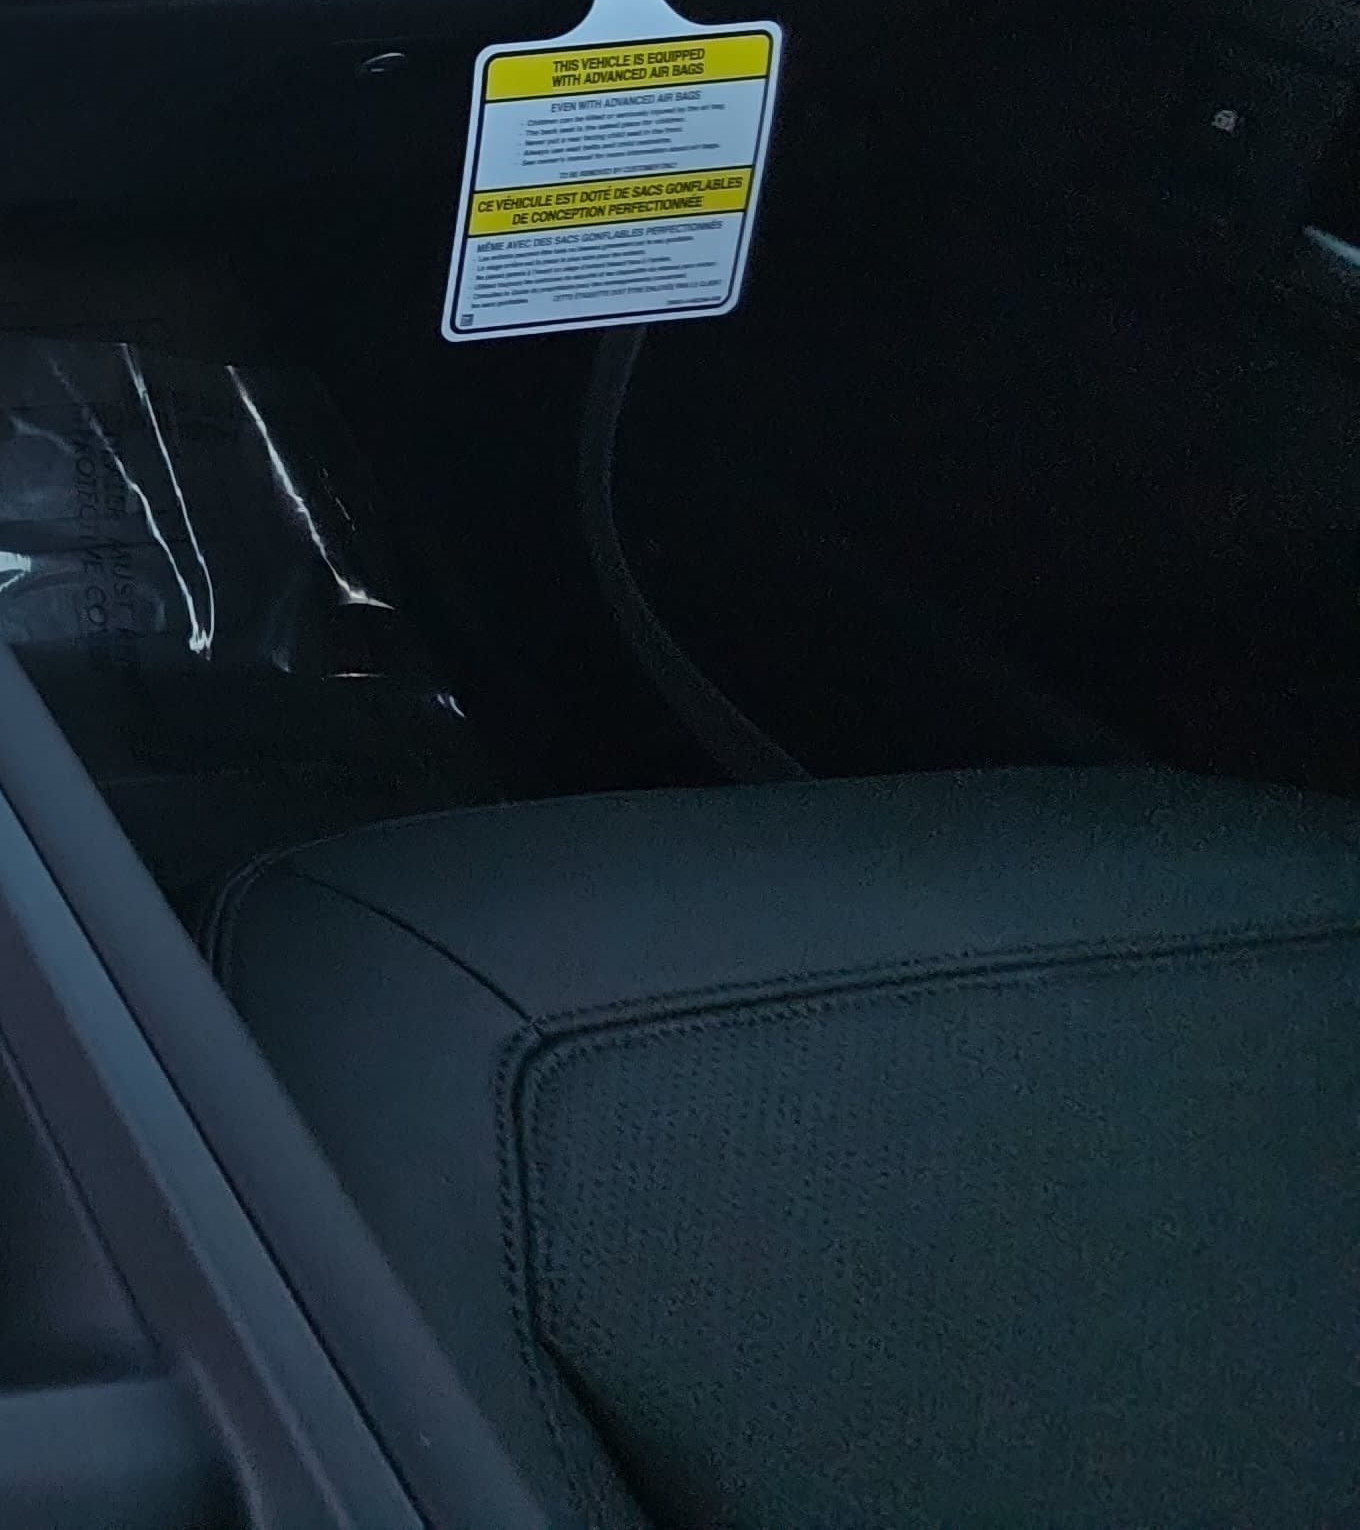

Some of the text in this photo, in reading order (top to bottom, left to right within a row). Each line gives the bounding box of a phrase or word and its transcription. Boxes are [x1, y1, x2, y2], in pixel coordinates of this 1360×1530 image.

[552, 48, 705, 73] THIS VEHICLE IS EQUIPPED
[552, 63, 705, 87] WITH ADVANCED AIR BAGS
[551, 90, 702, 113] EVEN WITH ADVANCED AIR BAGS
[477, 177, 743, 213] CE VÉHICULE EST DOTÉ DE SACS GONFLABLES
[512, 196, 704, 226] DE CONCEPTION PERFECTIONNÉE
